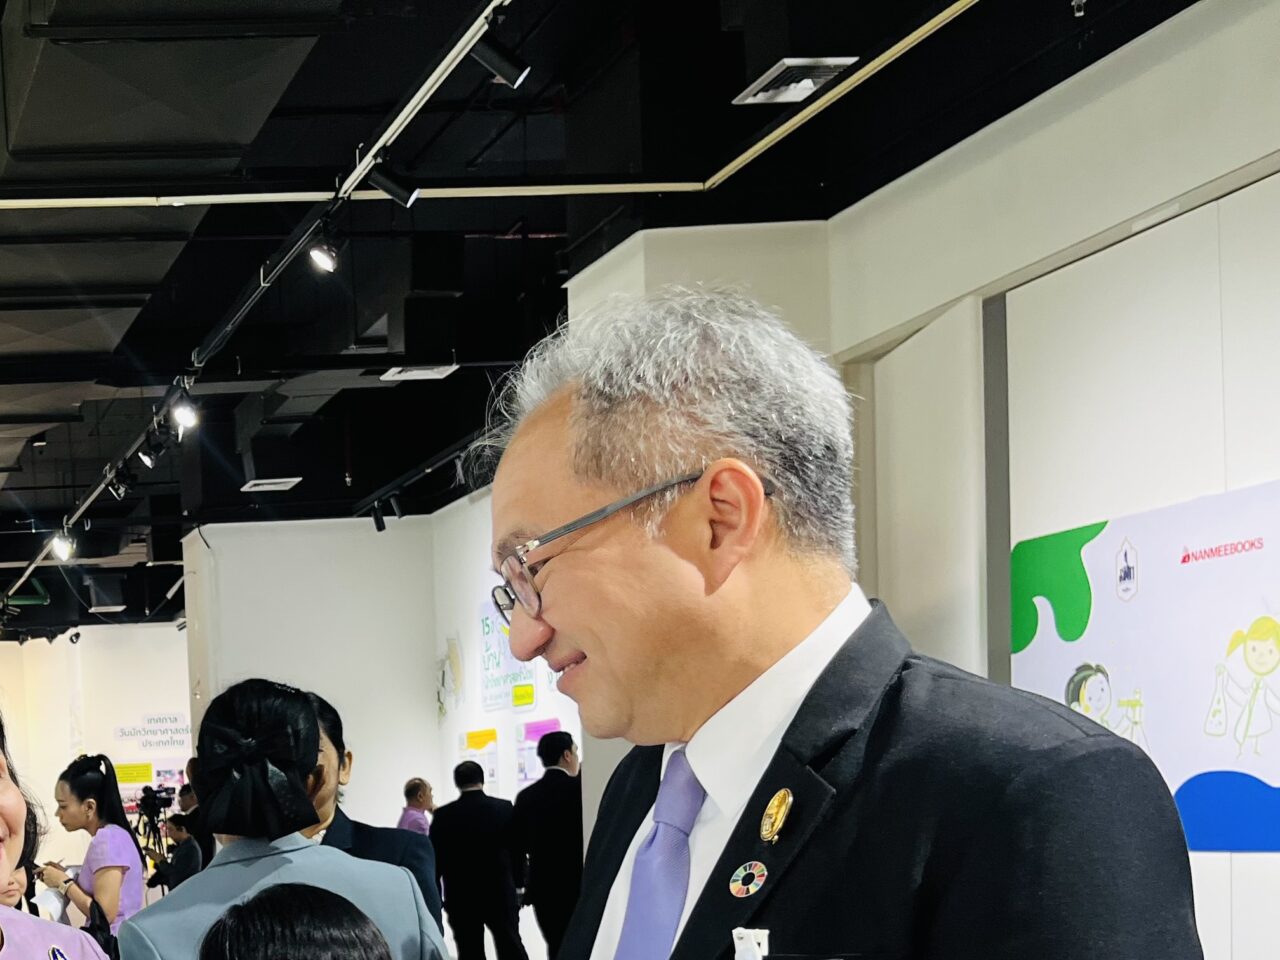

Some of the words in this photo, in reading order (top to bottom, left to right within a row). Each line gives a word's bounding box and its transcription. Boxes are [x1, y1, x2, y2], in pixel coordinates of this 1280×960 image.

[1190, 537, 1264, 562] NANMEEBOOKS
[147, 716, 178, 725] เทศกาล
[142, 736, 185, 748] ประเทศไทย
